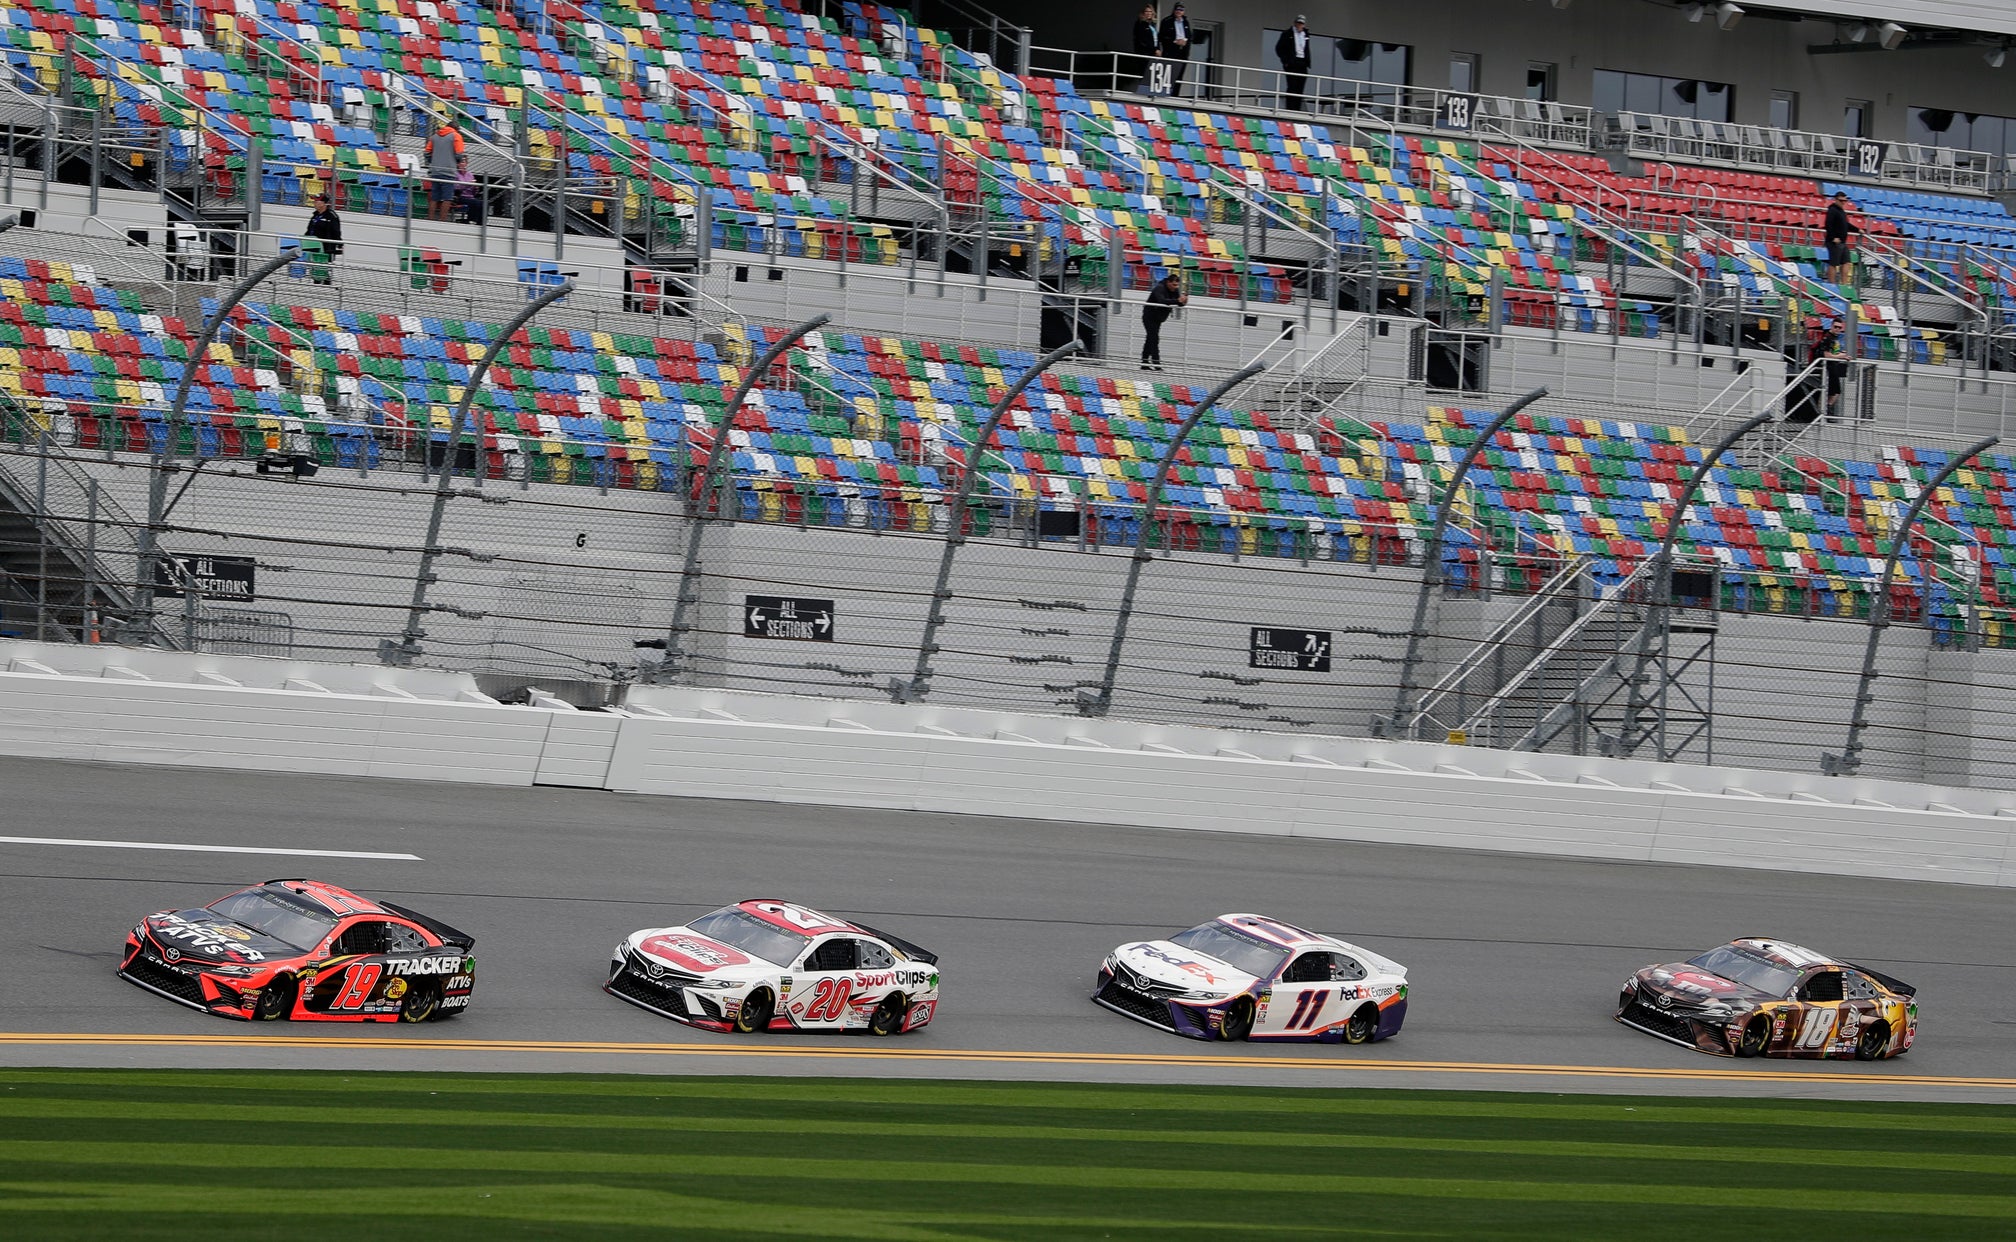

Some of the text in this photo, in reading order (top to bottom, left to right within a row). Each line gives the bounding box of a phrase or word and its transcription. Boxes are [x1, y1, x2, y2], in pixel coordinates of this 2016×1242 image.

[1149, 62, 1172, 94] 134
[1447, 96, 1469, 128] 133
[1859, 144, 1880, 175] 132
[577, 533, 587, 548] G
[196, 557, 216, 576] ALL
[780, 600, 798, 619] ALL
[766, 619, 814, 639] SECTIONS
[1255, 630, 1273, 648] ALL
[1255, 649, 1299, 668] SECTIONS
[147, 912, 266, 962] TRACKER
[147, 955, 191, 976] CAMRY
[386, 956, 462, 976] TRACKER
[1127, 943, 1228, 986] FedEx
[328, 962, 382, 1010] 19
[446, 975, 472, 990] ATVs
[632, 971, 673, 990] CAMRY
[802, 976, 854, 1023] 20
[1120, 982, 1160, 1001] CAMRY
[1340, 984, 1393, 1001] FedEx Express
[441, 995, 471, 1009] BOATS
[1284, 988, 1331, 1031] 11
[1642, 1001, 1681, 1019] CAMRY
[1794, 1007, 1838, 1048] 18
